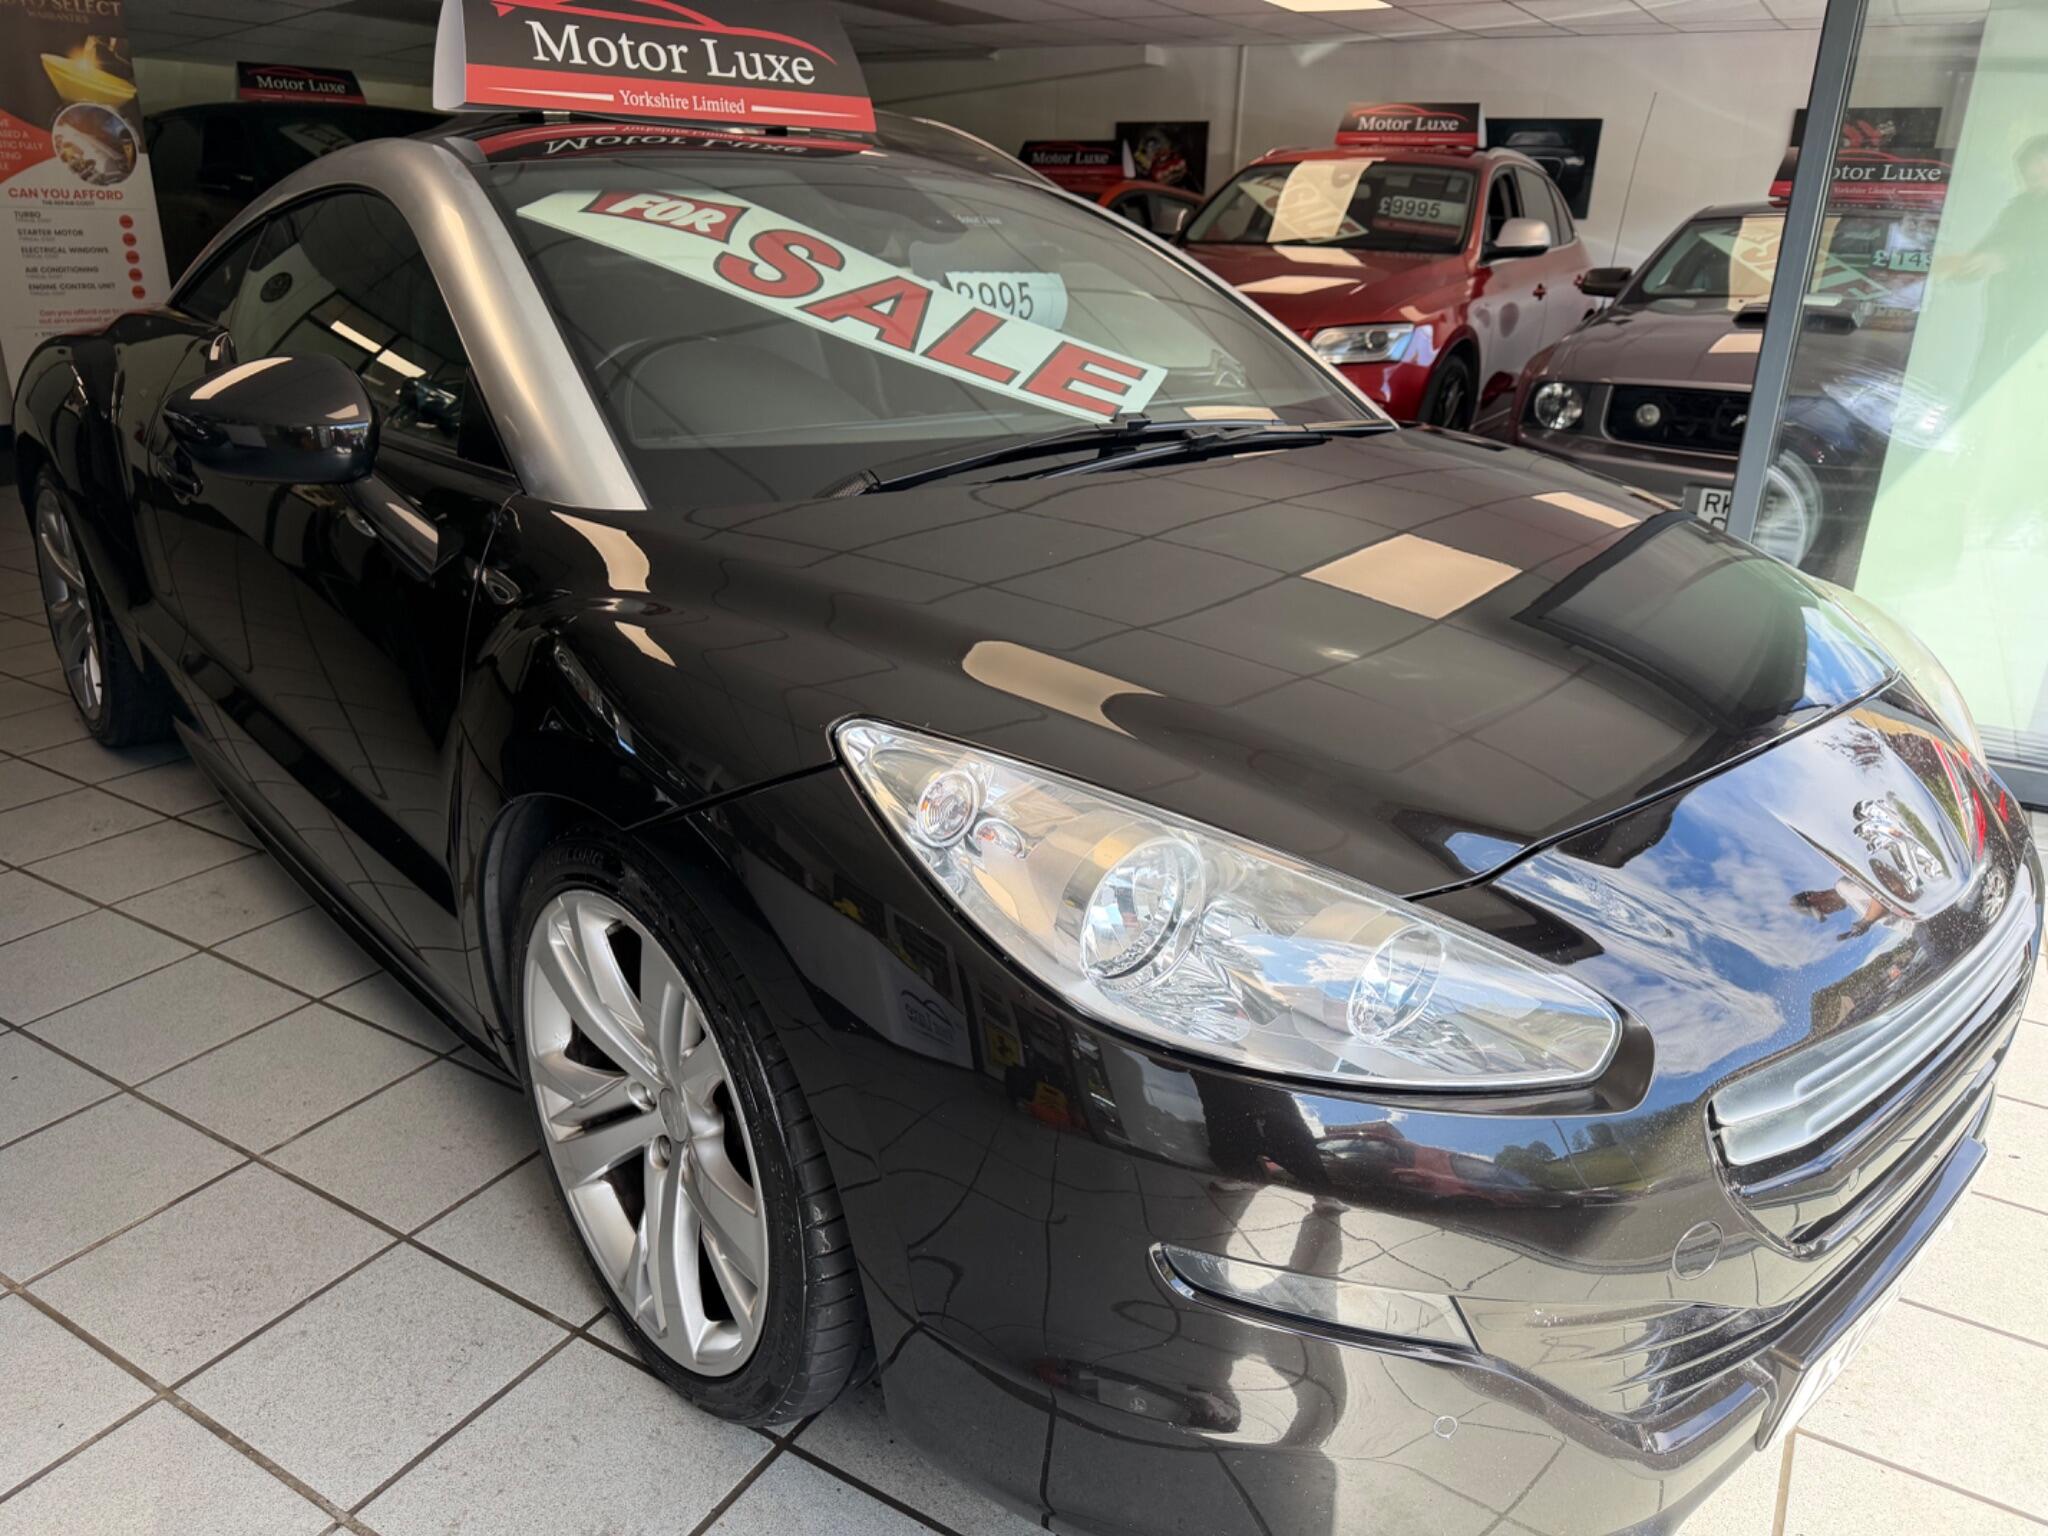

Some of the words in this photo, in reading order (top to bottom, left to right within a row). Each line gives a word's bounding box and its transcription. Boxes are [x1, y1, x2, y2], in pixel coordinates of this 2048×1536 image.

[525, 20, 689, 74] Motor
[700, 38, 816, 86] Luxe
[255, 75, 305, 91] Motor
[308, 79, 346, 94] Luxe
[619, 89, 689, 110] Yorkshire
[692, 95, 746, 115] Limited
[1357, 116, 1412, 131] Motor
[1415, 116, 1459, 131] Luxe
[1031, 151, 1073, 164] Motor
[1075, 151, 1110, 164] Luxe
[1831, 164, 1876, 180] otor
[1880, 163, 1942, 181] Luxe
[8, 188, 38, 199] CAN
[40, 188, 70, 199] YOU
[73, 189, 125, 201] AFFORD
[605, 193, 727, 233] FOR
[1377, 197, 1441, 219] £9995
[713, 229, 1148, 417] SALE
